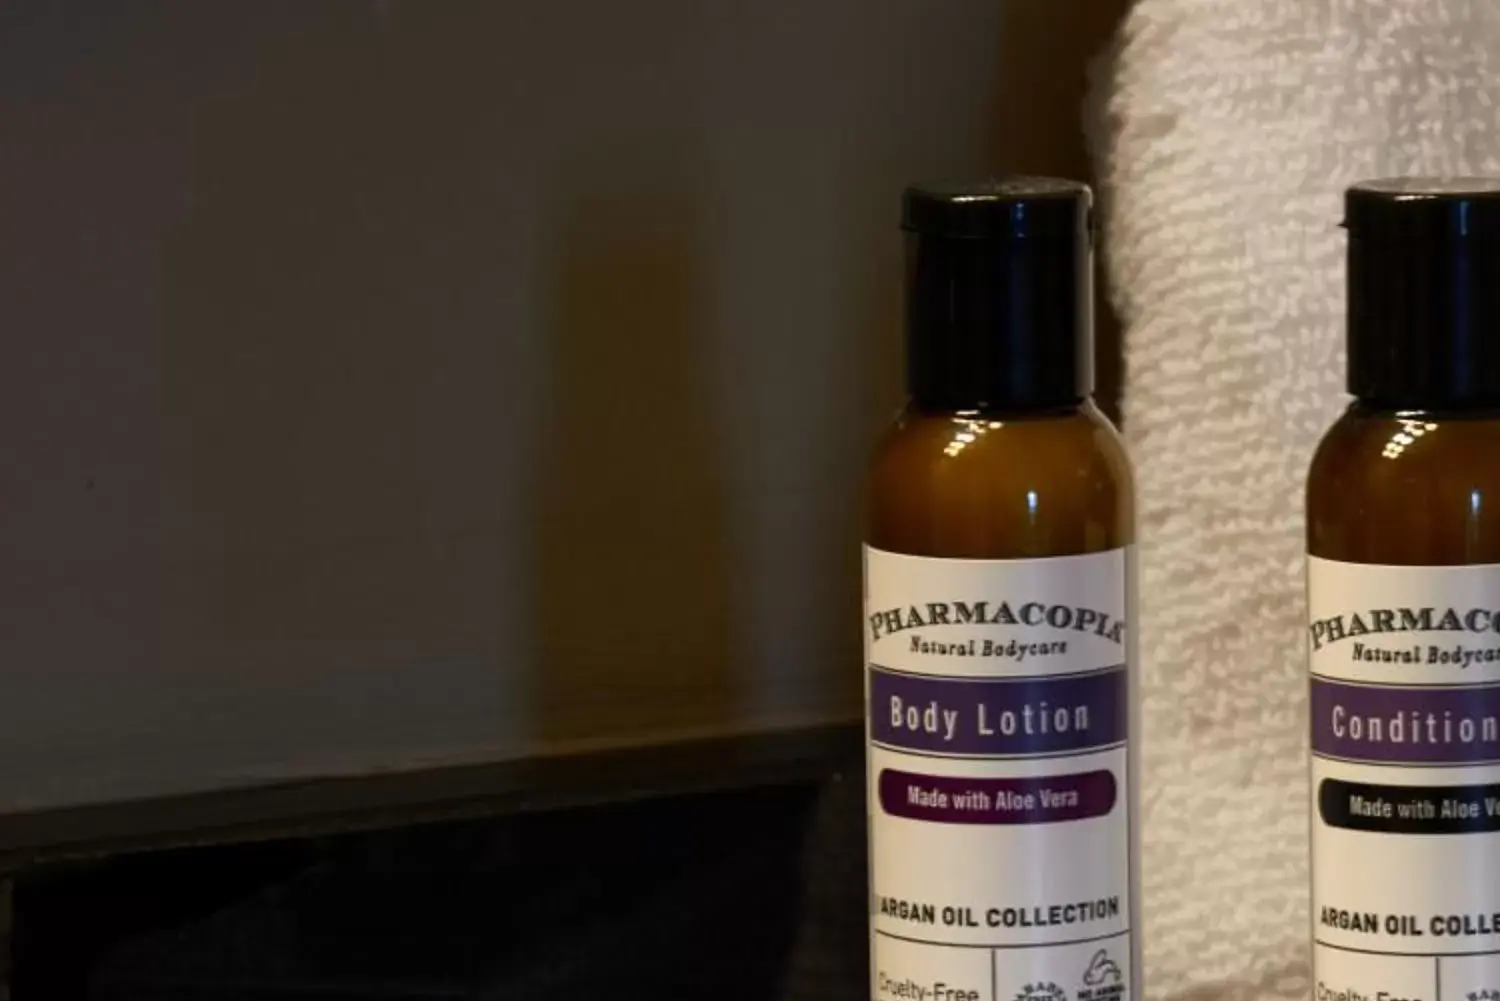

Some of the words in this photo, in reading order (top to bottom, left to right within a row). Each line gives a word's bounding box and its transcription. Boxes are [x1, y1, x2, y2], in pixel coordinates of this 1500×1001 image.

[910, 636, 974, 657] Natural
[982, 640, 1068, 661] Bodycare
[1352, 643, 1420, 664] Natural
[890, 696, 958, 741] Body
[978, 702, 1089, 735] Lotion
[907, 785, 947, 809] Made
[953, 788, 990, 810] with
[996, 789, 1033, 810] Aloe
[1039, 788, 1079, 808] Vera
[1349, 795, 1392, 817] Made
[1398, 799, 1435, 819] with
[1441, 798, 1478, 819] Aloe
[880, 897, 935, 925] ARGAN
[942, 907, 979, 927] OIL
[986, 896, 1119, 928] COLLECTION
[1320, 905, 1378, 933] ARGAN
[1385, 915, 1422, 936] OIL
